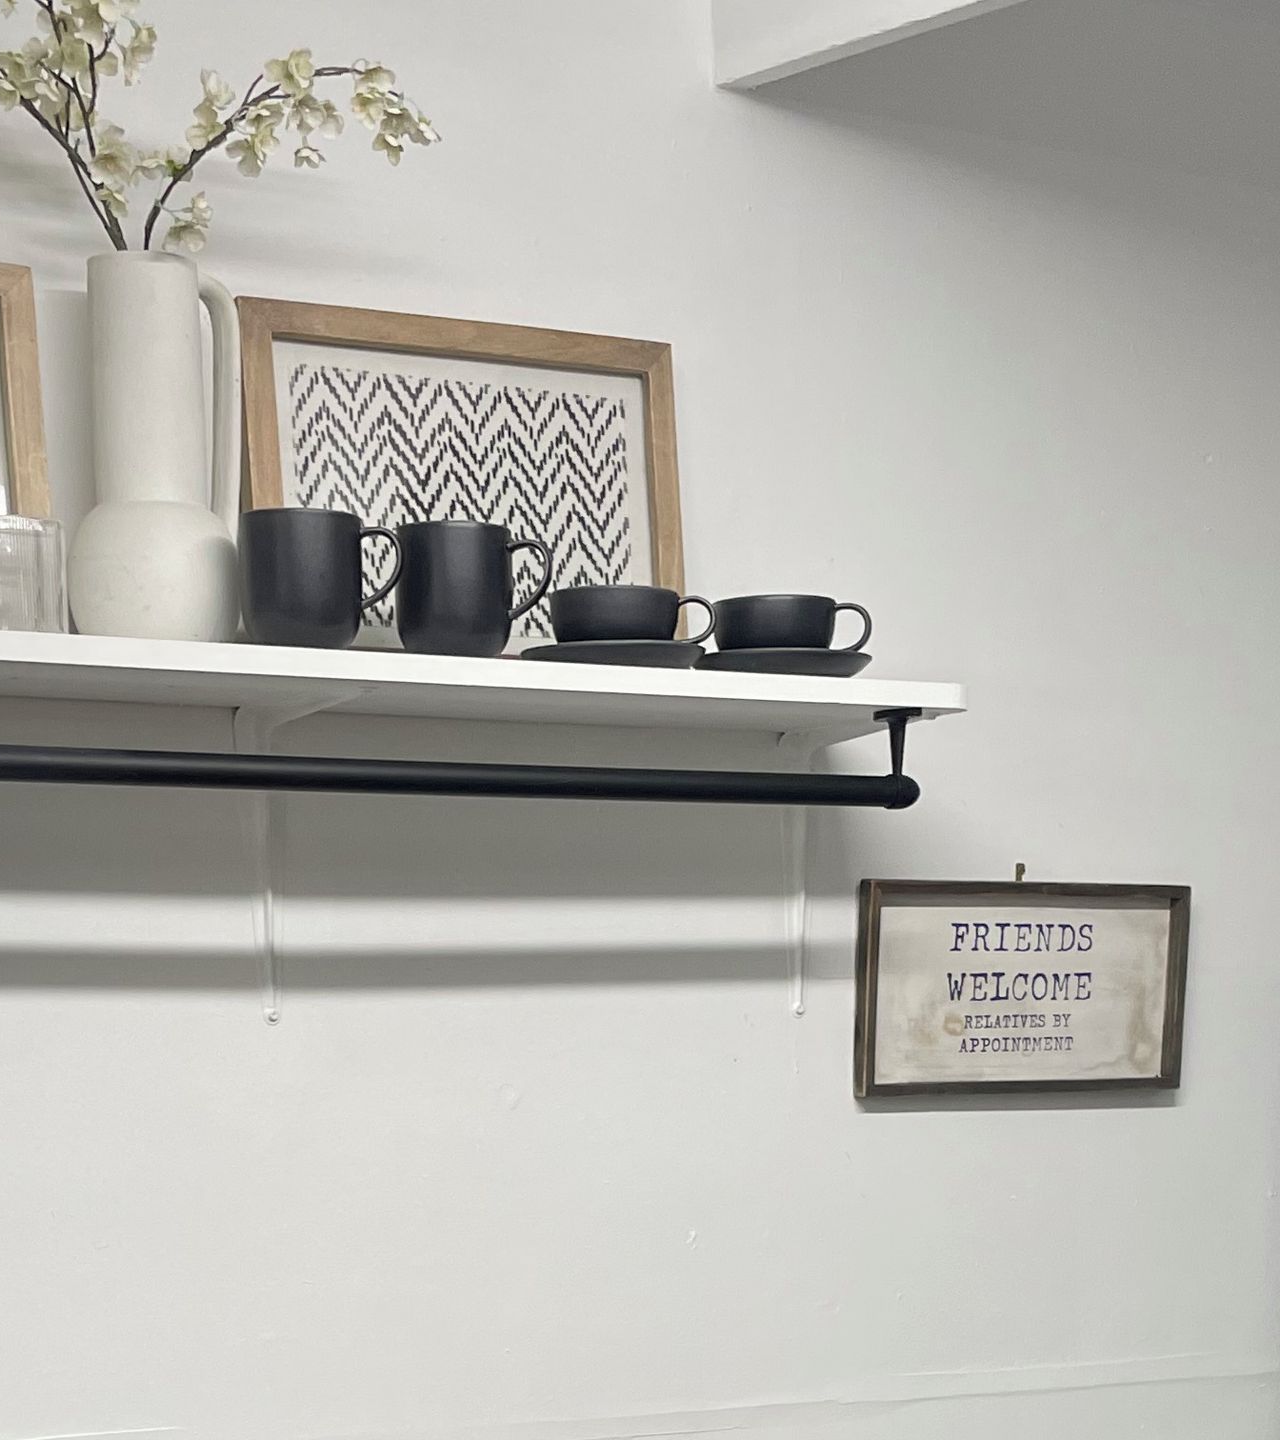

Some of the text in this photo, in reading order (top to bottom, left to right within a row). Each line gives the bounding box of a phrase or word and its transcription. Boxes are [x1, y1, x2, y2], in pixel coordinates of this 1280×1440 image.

[949, 922, 1094, 952] FRIENDS
[946, 972, 1093, 1002] WELCOME
[963, 1013, 1072, 1030] RELATIVES BY
[958, 1036, 1074, 1053] APPOINTMENT
